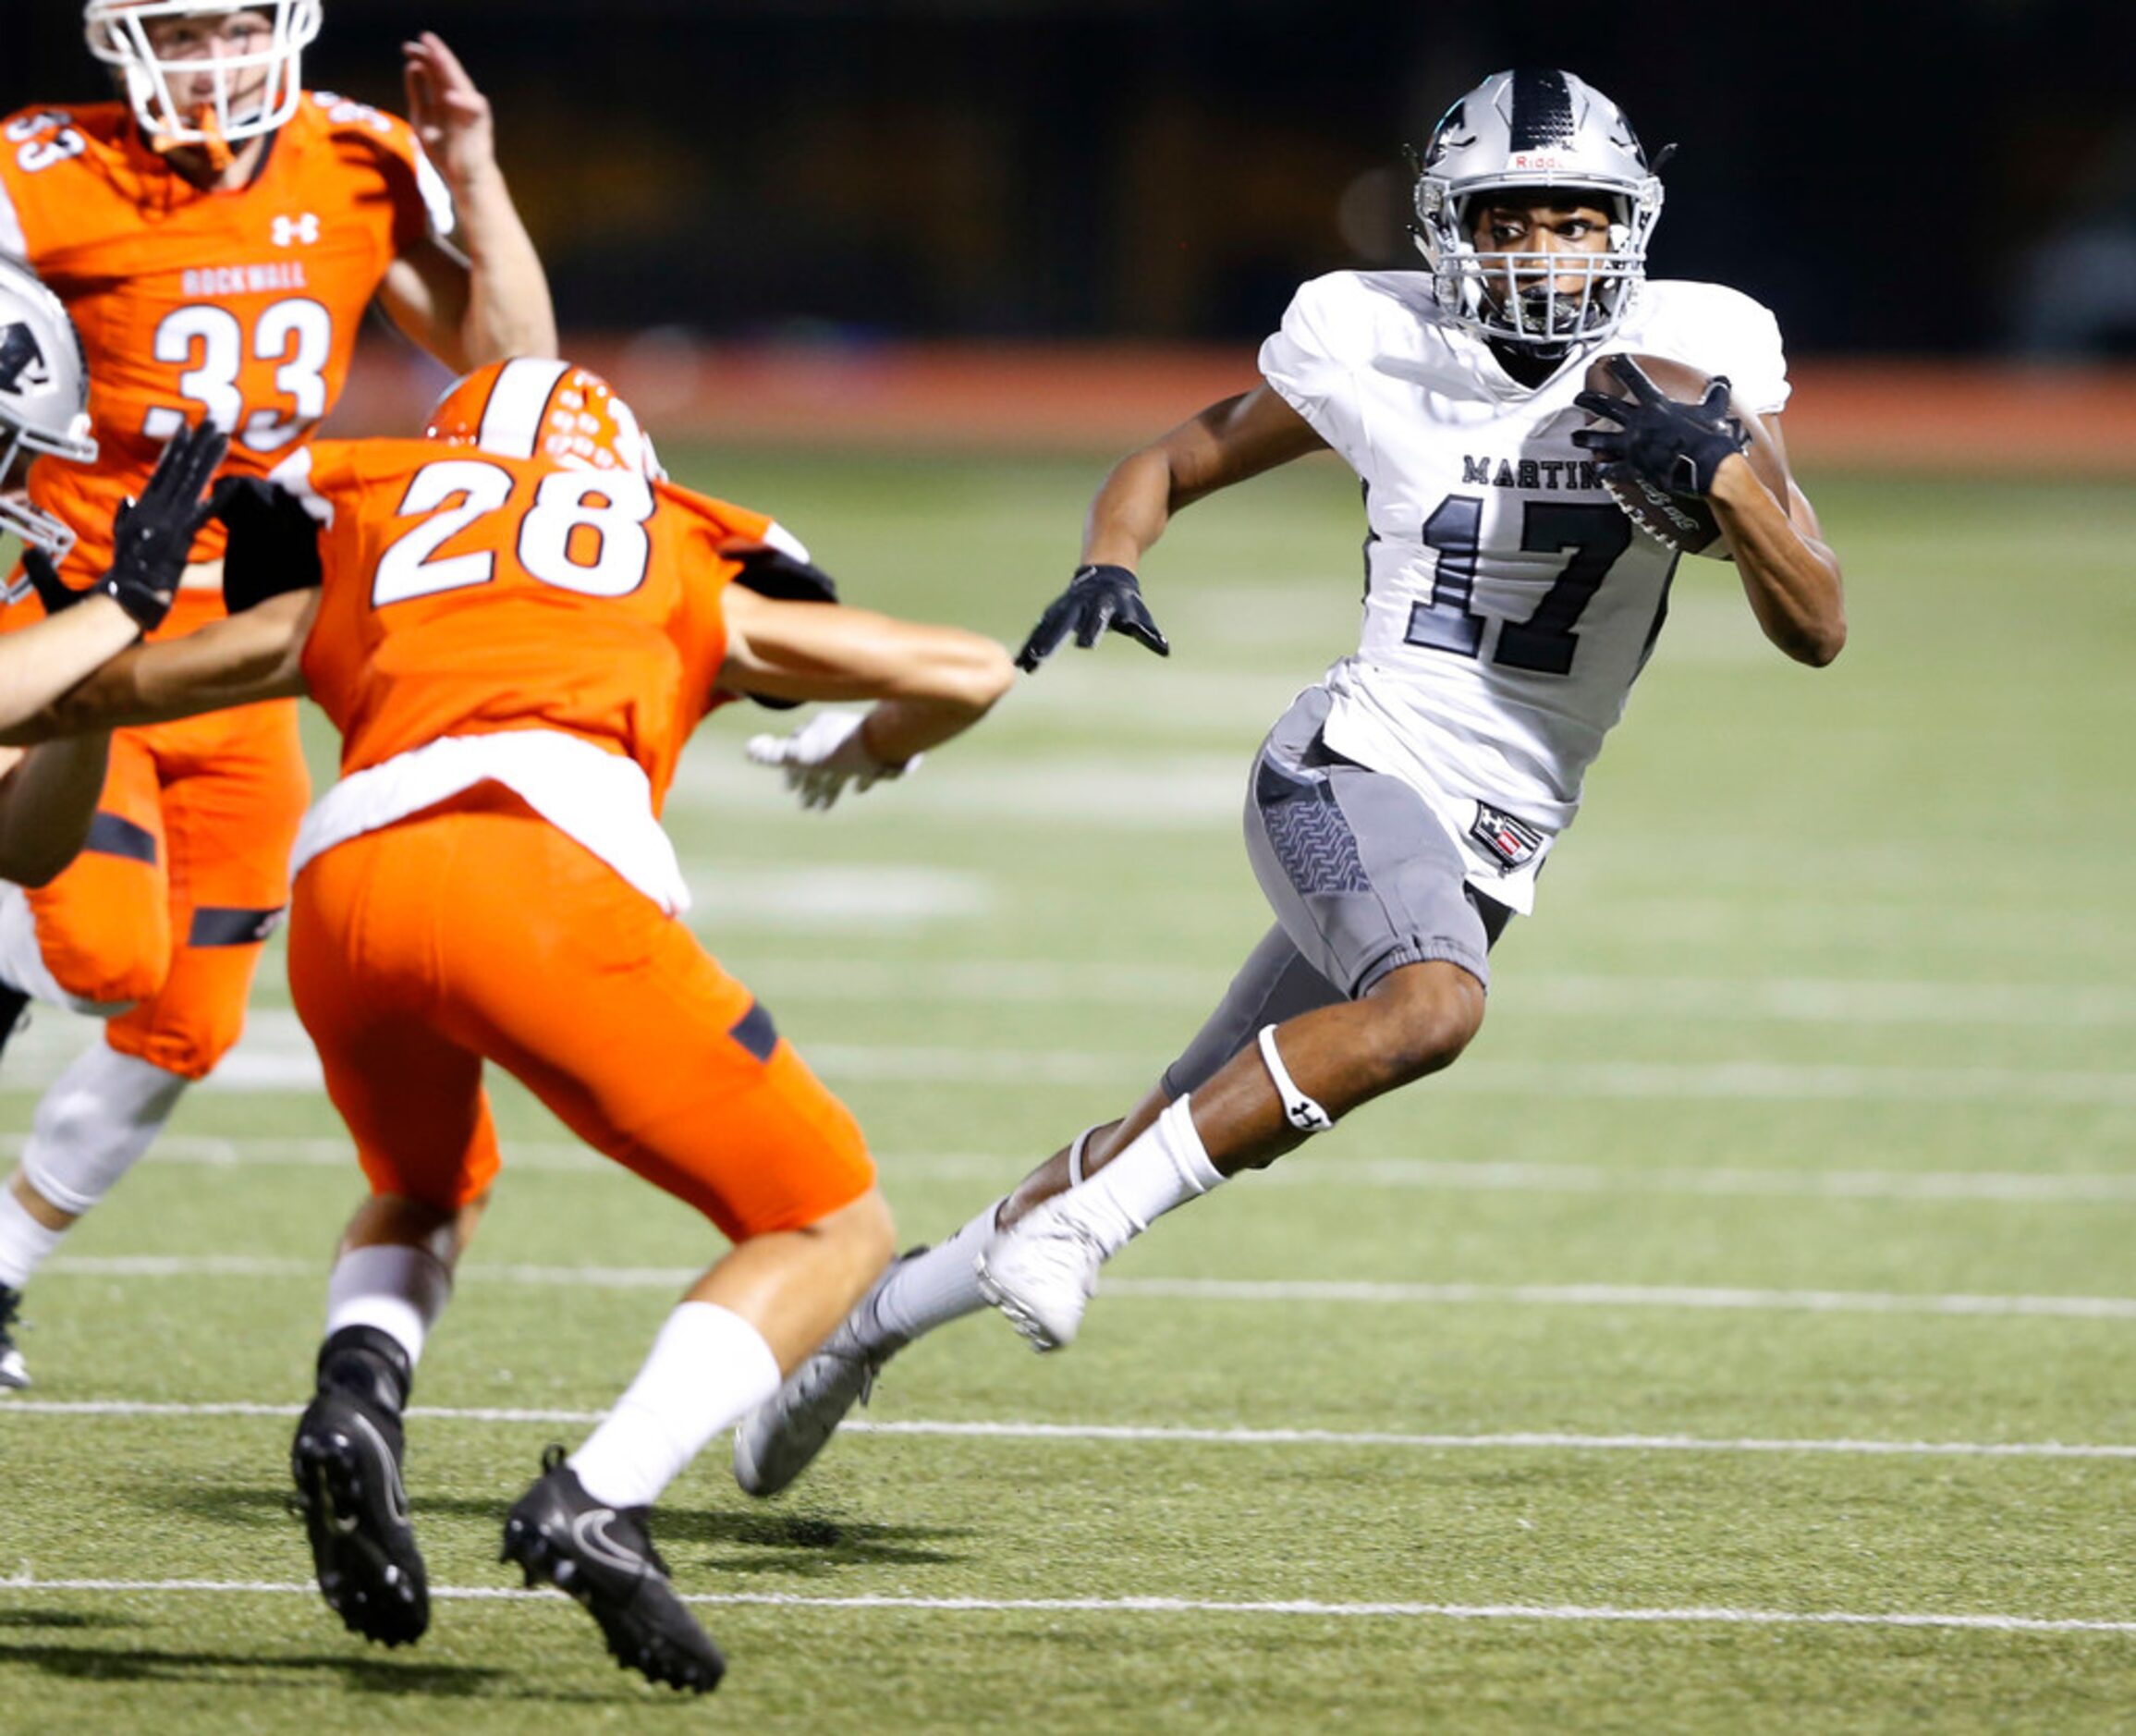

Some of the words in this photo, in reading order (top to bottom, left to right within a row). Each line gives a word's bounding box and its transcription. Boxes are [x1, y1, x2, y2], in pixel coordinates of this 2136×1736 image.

[182, 262, 307, 297] ROCKWALL
[142, 296, 333, 453] 33
[371, 458, 657, 610] 28
[1462, 455, 1604, 490] MARTIN
[1403, 494, 1634, 676] 17
